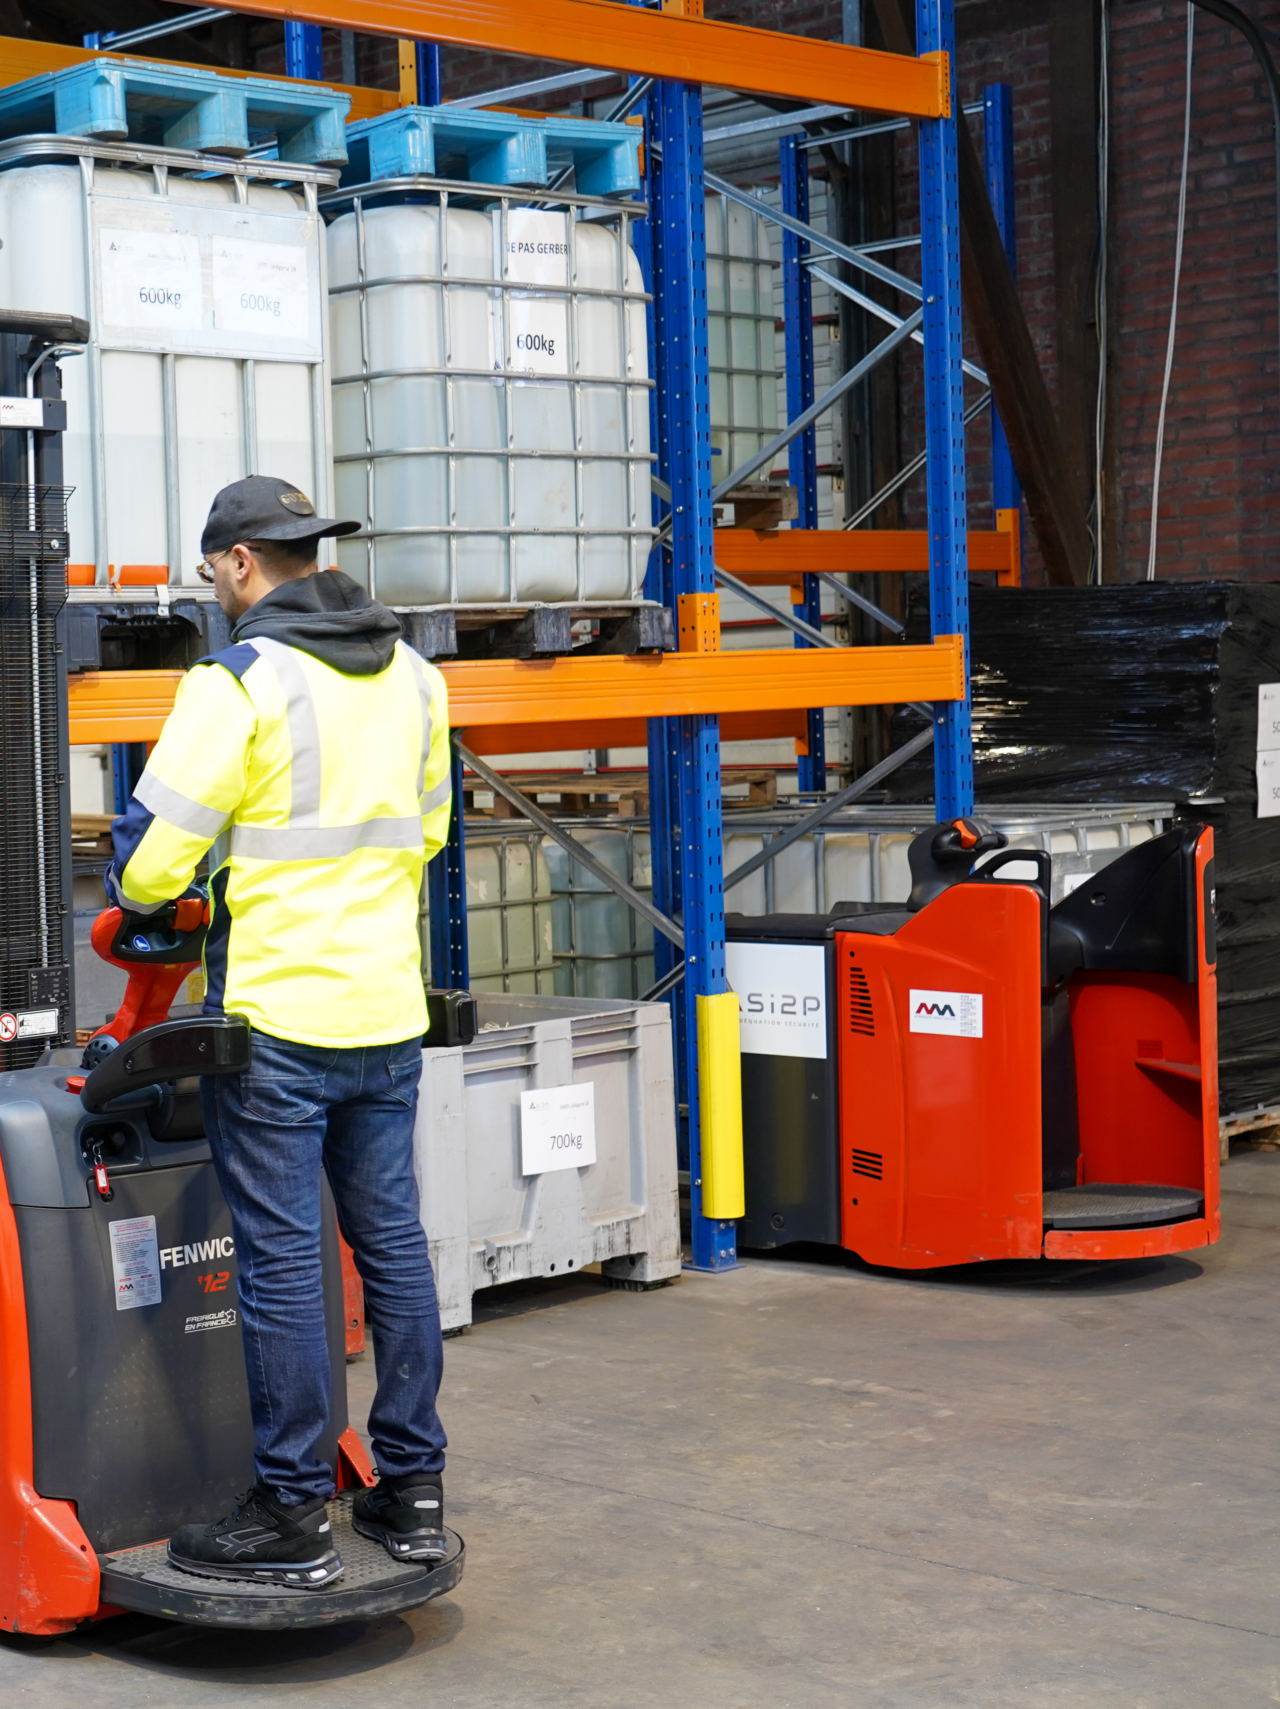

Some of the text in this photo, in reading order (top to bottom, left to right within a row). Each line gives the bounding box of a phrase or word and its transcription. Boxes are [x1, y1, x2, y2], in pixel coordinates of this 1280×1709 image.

[518, 242, 535, 254] PAS
[537, 243, 568, 255] GERBER
[139, 287, 182, 309] 600kg
[240, 293, 281, 317] 600kg
[516, 333, 555, 356] 600kg
[739, 1017, 819, 1029] DÉQUATION SÉCURITÉ
[550, 1132, 583, 1151] 700kg
[160, 1236, 237, 1270] FENWIC
[184, 1318, 227, 1331] EN FRANCE
[185, 1310, 225, 1324] FABRIQUÉ
